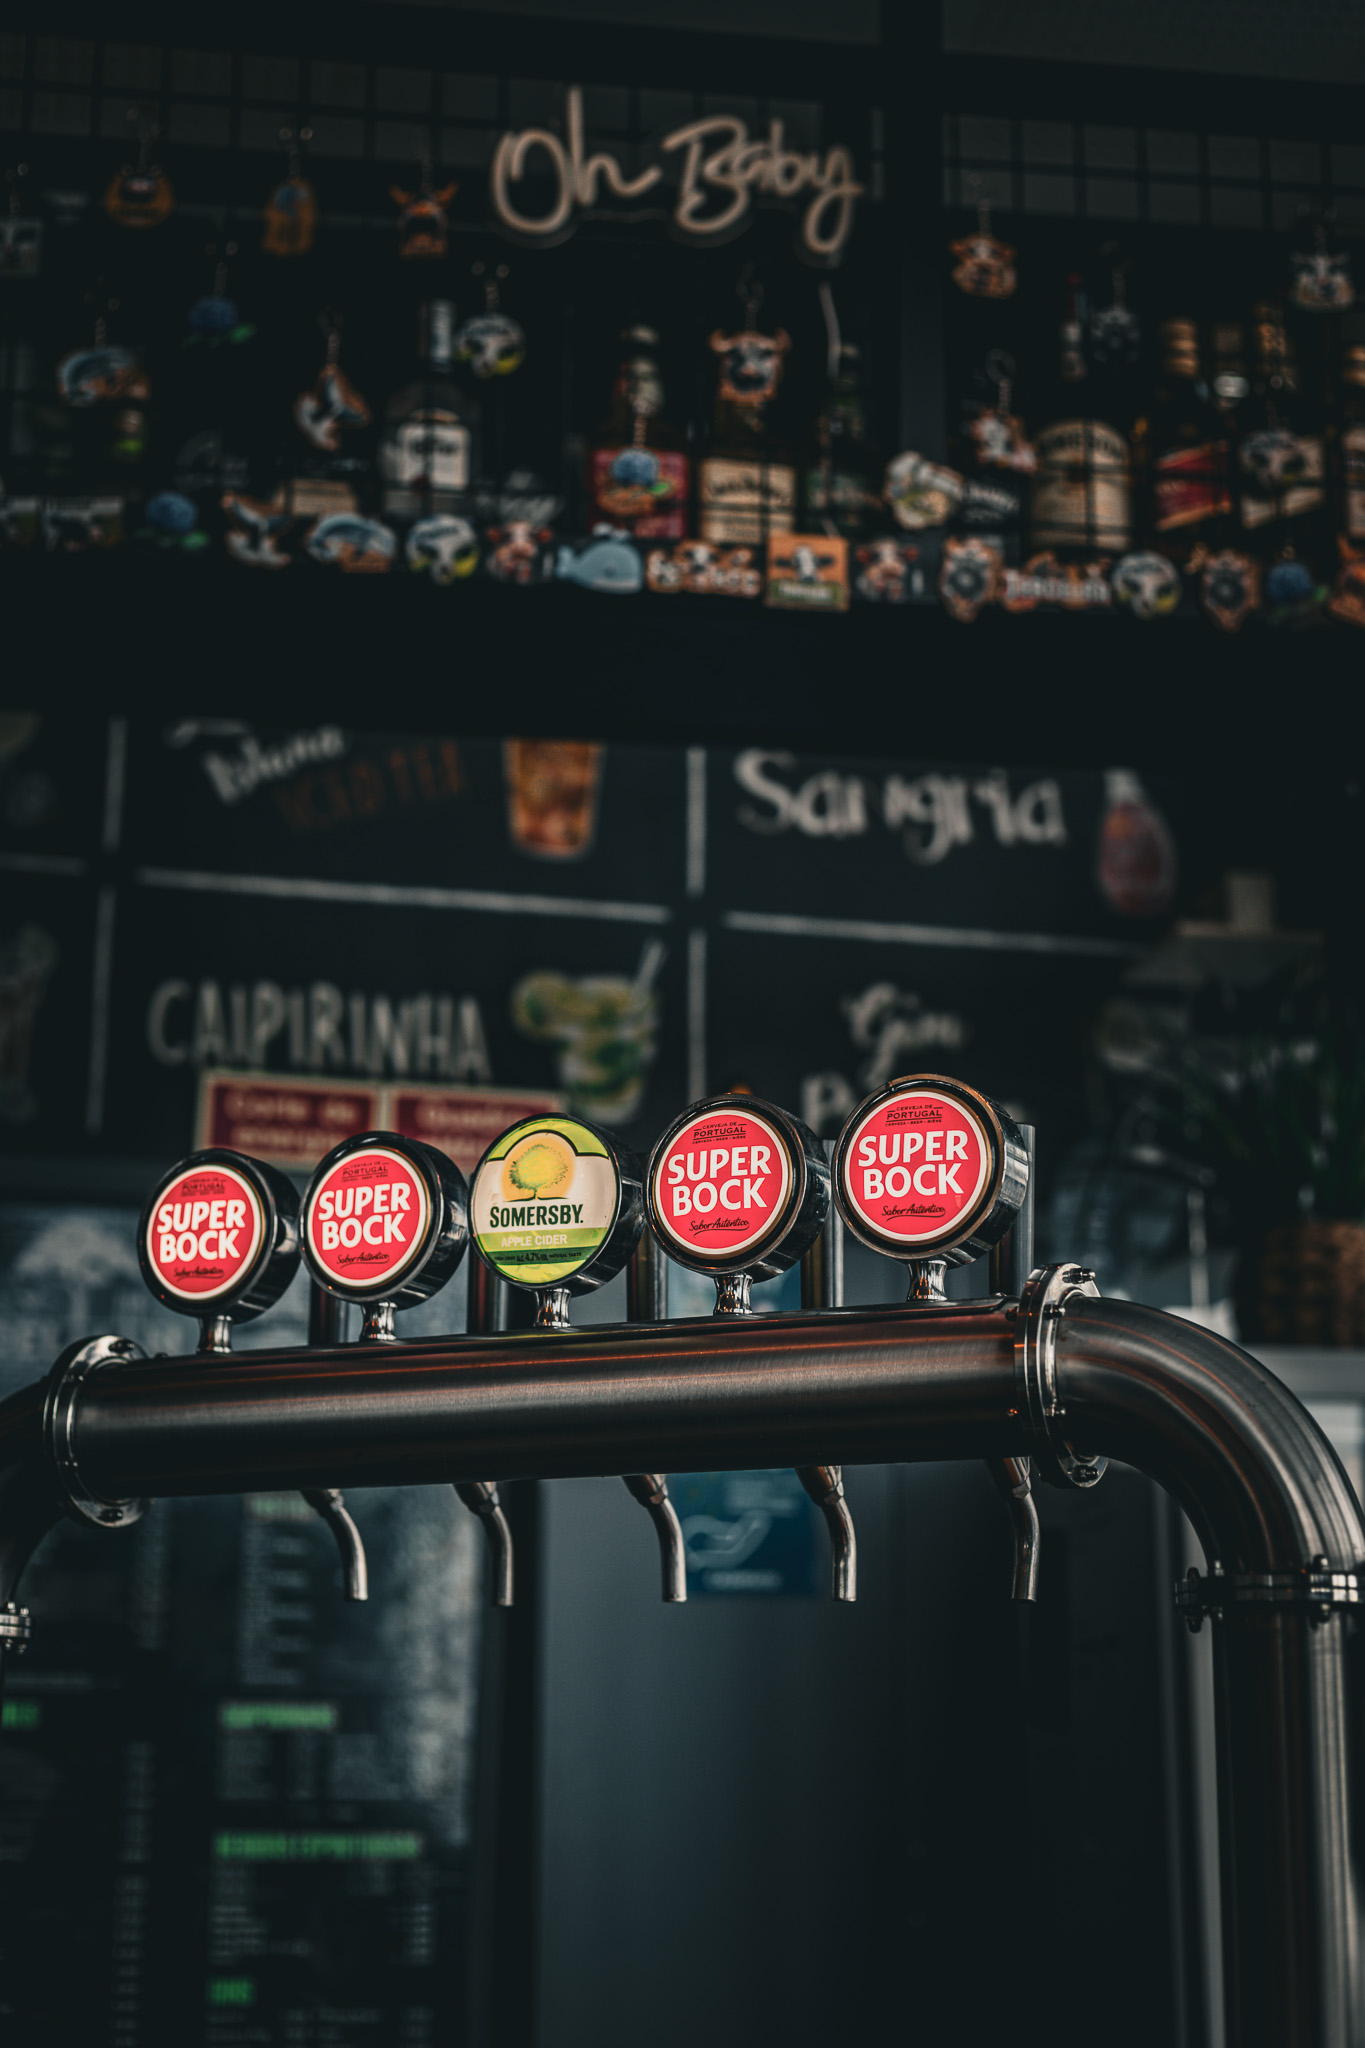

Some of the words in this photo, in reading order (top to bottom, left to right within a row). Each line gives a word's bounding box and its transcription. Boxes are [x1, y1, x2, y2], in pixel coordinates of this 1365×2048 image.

[490, 84, 664, 235] Oh
[660, 114, 866, 254] Baby
[732, 746, 1067, 867] Sangria
[146, 977, 494, 1082] CAIPIRINHA
[693, 1126, 746, 1138] PORTUGAL
[886, 1110, 943, 1120] PORTUGAL
[667, 1145, 772, 1185] SUPER
[858, 1130, 969, 1167] SUPER
[342, 1165, 389, 1176] PORTUGAL
[863, 1163, 964, 1200] BOCK
[318, 1182, 411, 1220] SUPER
[672, 1177, 768, 1217] BOCK
[882, 1204, 906, 1216] Sabor
[157, 1199, 246, 1233] SUPER
[322, 1213, 406, 1250] BOCK
[689, 1219, 712, 1231] Sabor
[159, 1229, 241, 1263] BOCK
[501, 1236, 532, 1247] APPLE
[535, 1234, 567, 1245] CIDER
